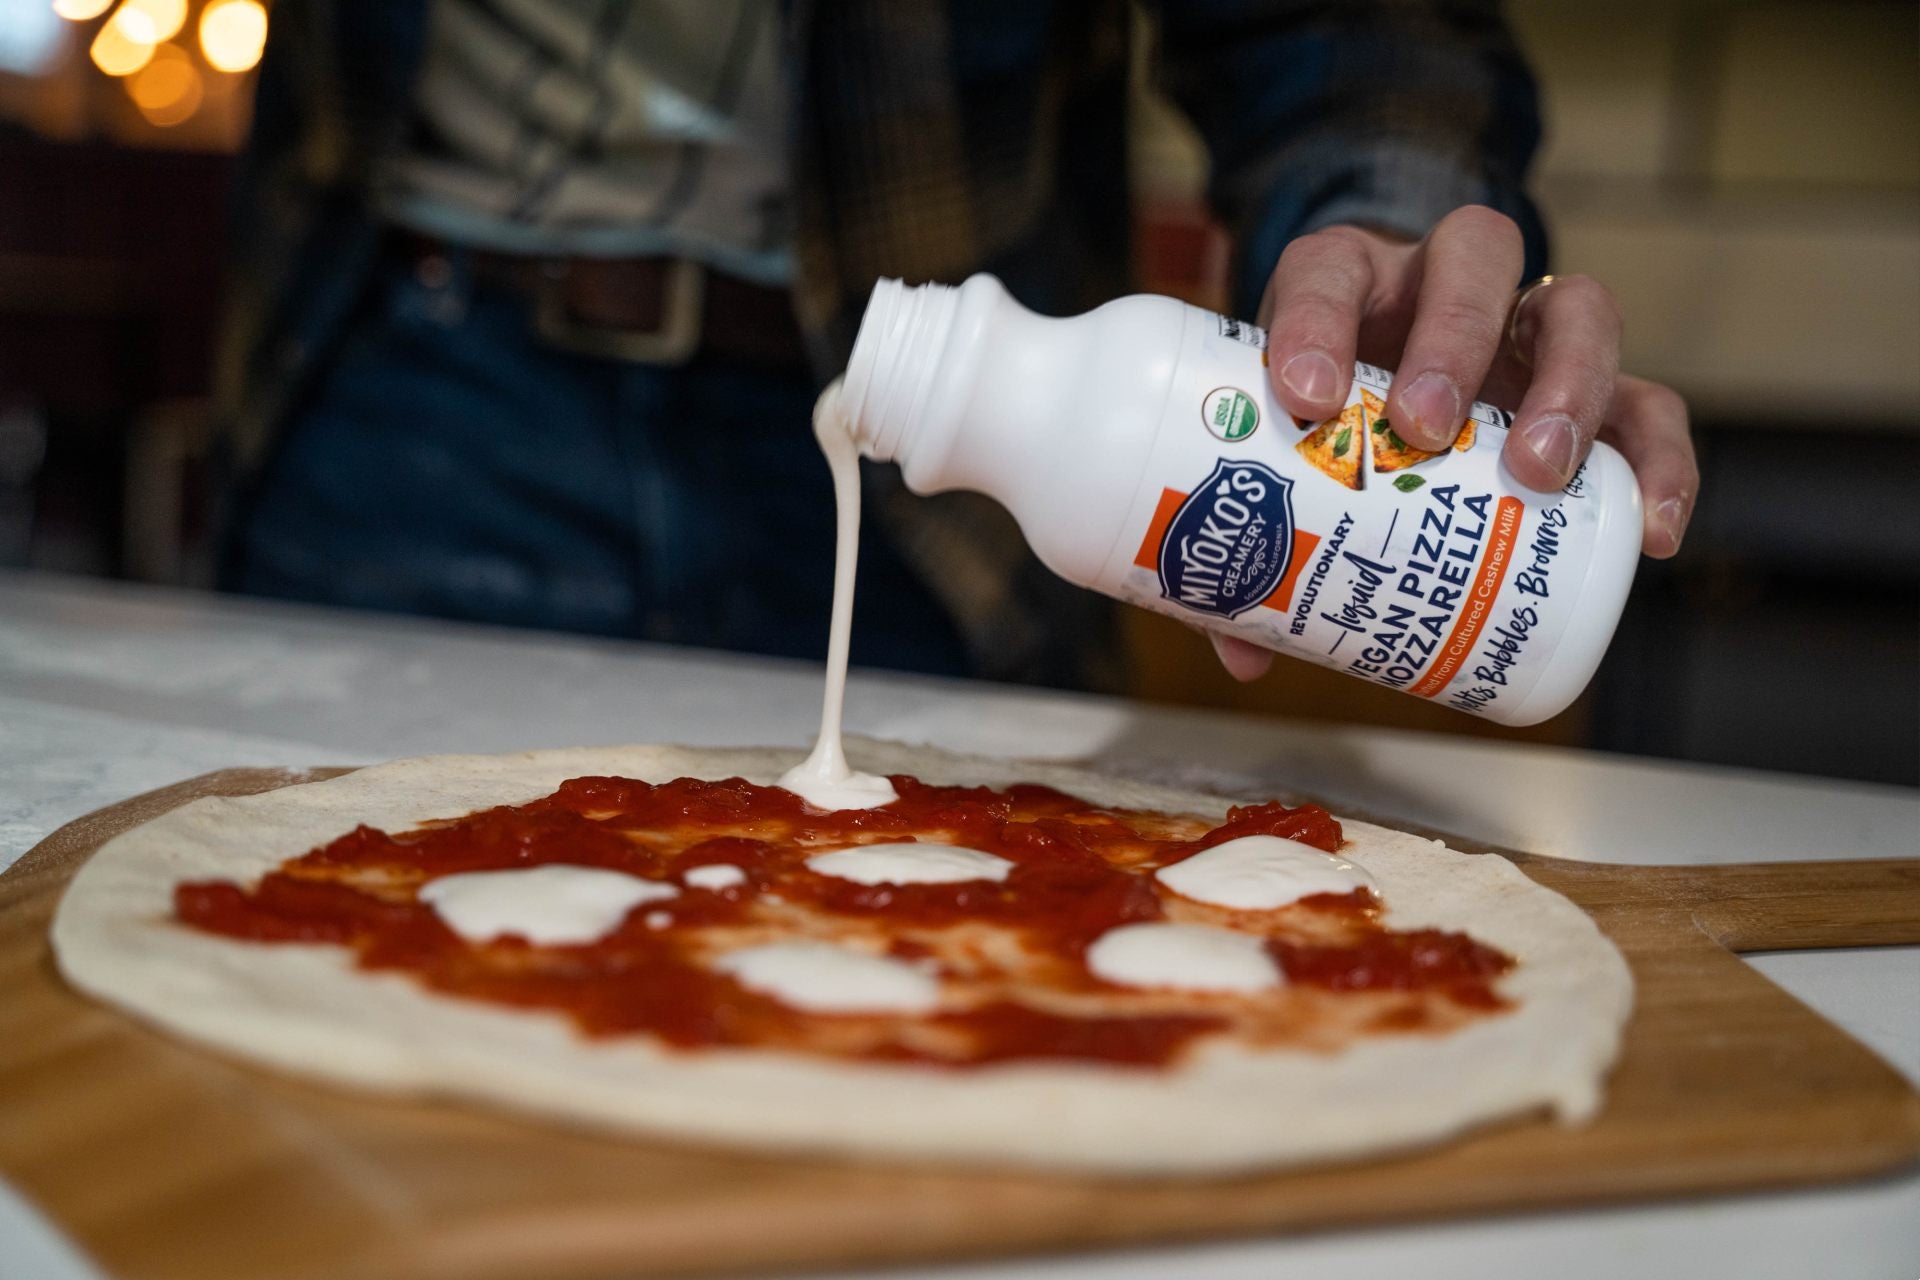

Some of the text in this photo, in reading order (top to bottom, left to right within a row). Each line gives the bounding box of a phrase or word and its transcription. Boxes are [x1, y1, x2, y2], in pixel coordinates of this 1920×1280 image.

[1180, 469, 1266, 606] MIYOKO'S
[1222, 513, 1266, 597] CREAMERY
[1244, 522, 1283, 601] SONOMA CALIFORNIA
[1290, 511, 1355, 636] REVOLUTIONARY
[1320, 551, 1396, 633] liquid
[1343, 484, 1461, 677] VEGAN PIZZA
[1377, 494, 1492, 687] MOZZARELLA
[1433, 657, 1456, 680] from
[1450, 599, 1486, 656] Cultured
[1479, 540, 1508, 598] Cashew
[1502, 504, 1517, 537] Milk
[1473, 601, 1539, 686] Bubbles.
